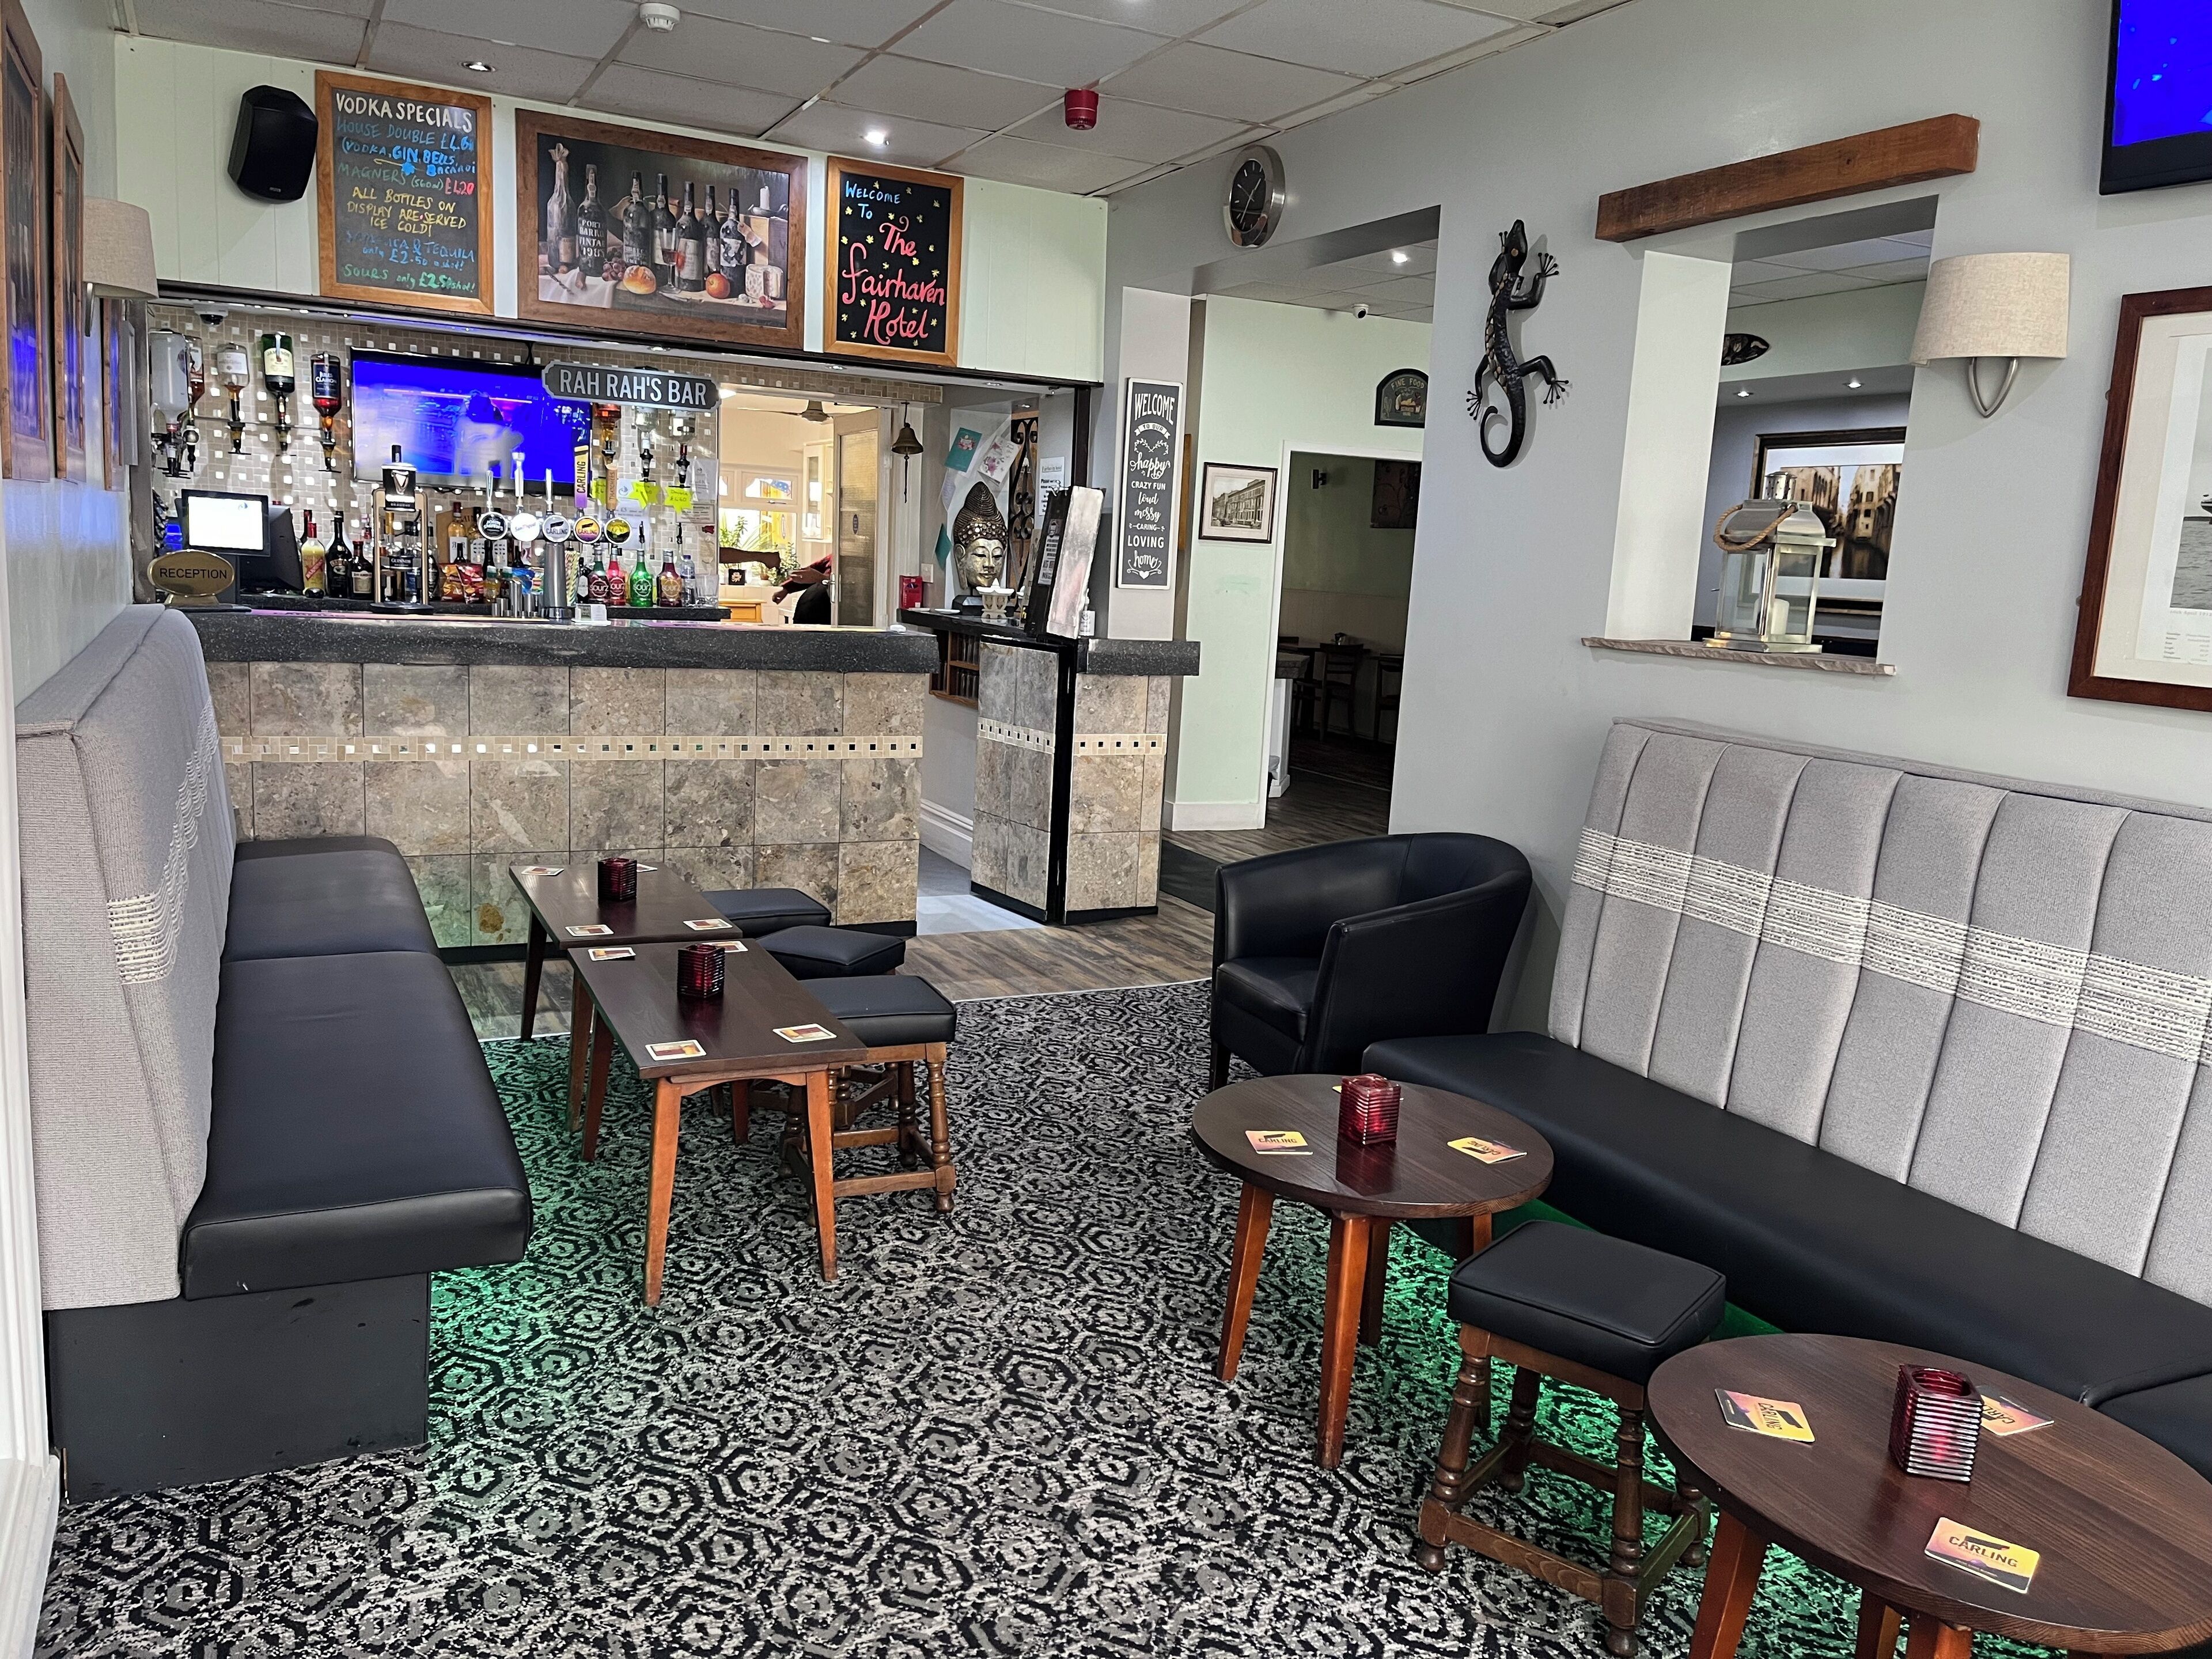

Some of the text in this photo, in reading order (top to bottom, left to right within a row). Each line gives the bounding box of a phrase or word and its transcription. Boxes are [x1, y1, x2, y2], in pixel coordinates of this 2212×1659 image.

[336, 93, 472, 134] VODKA SPECIALS
[337, 116, 382, 138] HOUSE
[387, 124, 435, 145] DOUBLE
[338, 162, 406, 185] MAGNERS
[352, 186, 456, 213] ALL BOTTLES ON
[845, 180, 901, 204] WELCOME
[347, 201, 467, 229] DISPLAY ARE SERVED
[370, 216, 389, 229] ICE
[879, 215, 917, 257] The
[343, 263, 389, 280] SOURS
[396, 273, 415, 290] only
[864, 298, 929, 345] Hotel
[560, 369, 706, 406] RAH RAH'S BAR
[1391, 378, 1425, 391] FINE FOOD
[1134, 393, 1176, 425] WELCOME
[577, 460, 586, 494] CARLING
[1130, 452, 1171, 480] happy
[1131, 481, 1166, 490] CRAZY FUN
[1138, 491, 1160, 505] loud
[1134, 509, 1161, 523] messy
[1136, 523, 1157, 532] CARING
[1127, 535, 1164, 548] LOVING
[1133, 550, 1158, 568] home
[160, 568, 227, 579] RECEPTION
[1467, 1141, 1501, 1155] CARLING
[1758, 1403, 1782, 1430] CARLING
[1982, 1405, 2016, 1424] CARL
[1949, 1536, 2018, 1567] CARLING
